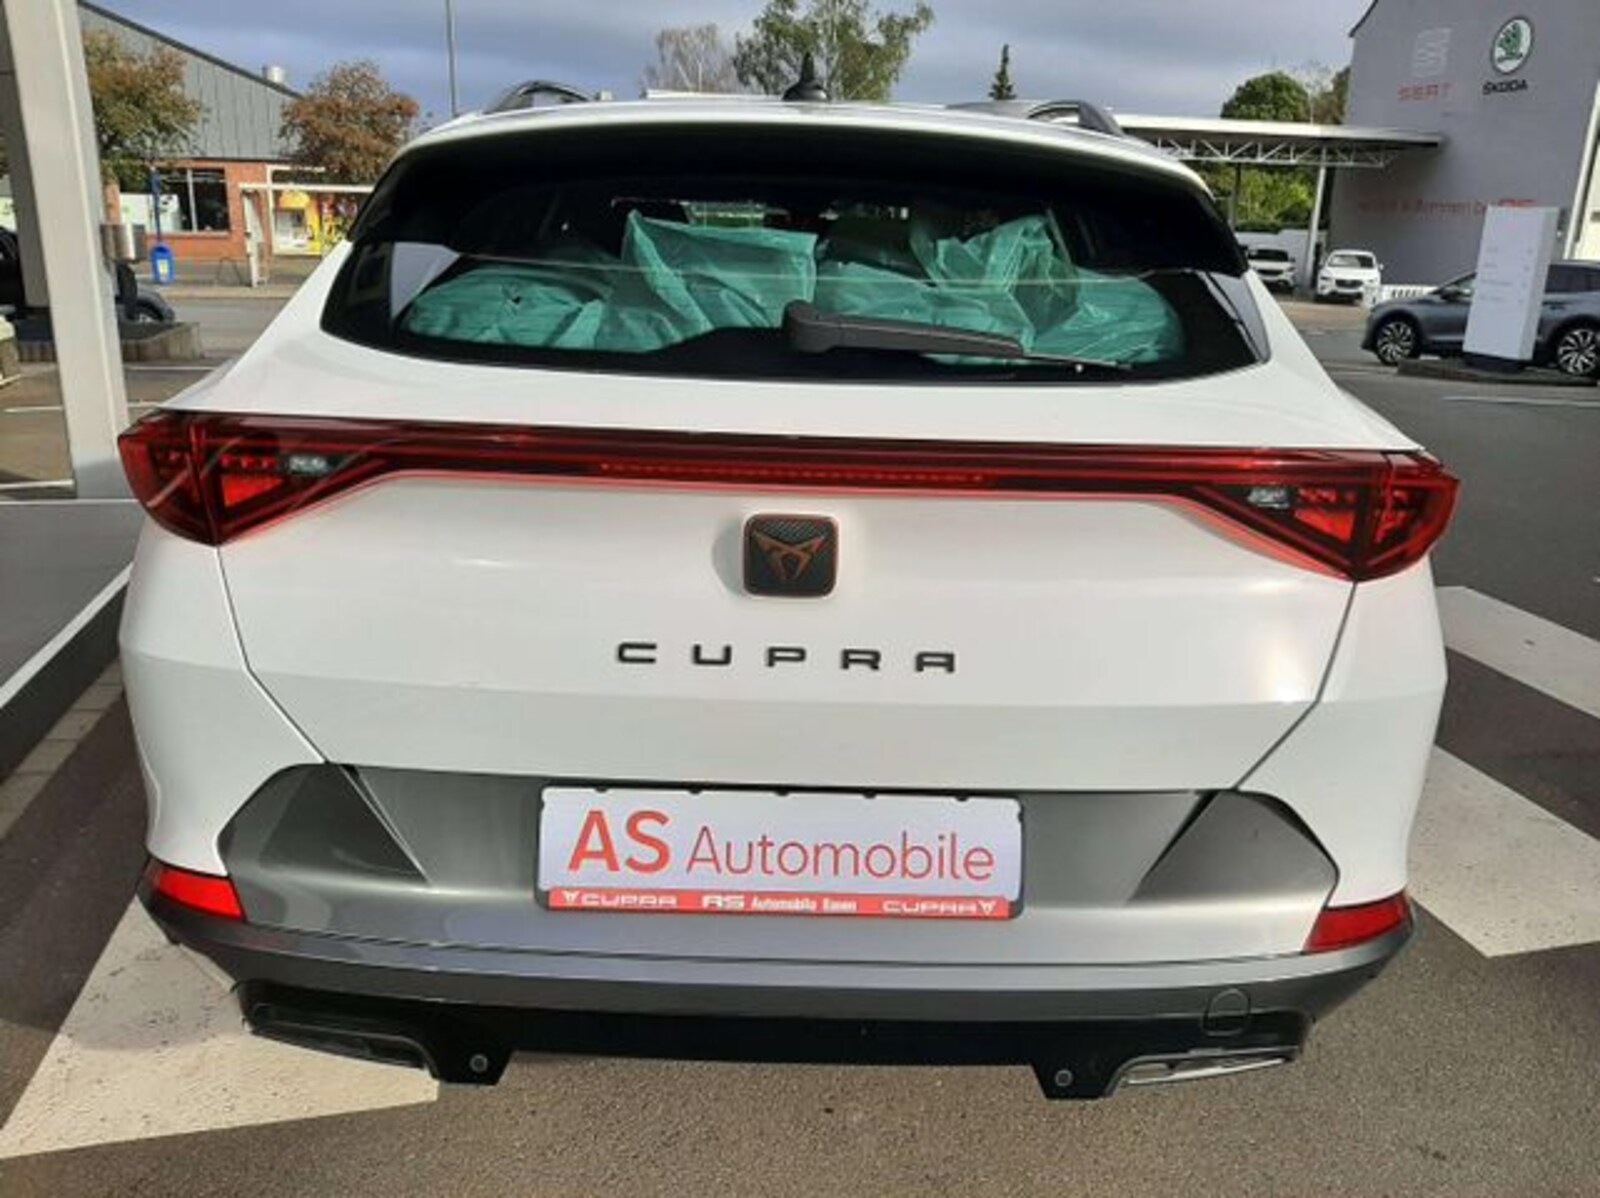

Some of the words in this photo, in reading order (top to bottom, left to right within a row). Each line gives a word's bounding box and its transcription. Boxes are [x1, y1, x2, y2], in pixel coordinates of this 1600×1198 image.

[617, 642, 955, 673] CUPRA
[568, 810, 671, 873] AS
[686, 825, 994, 880] Automobile
[581, 895, 677, 908] CUPRA
[882, 901, 977, 914] CUPRA
